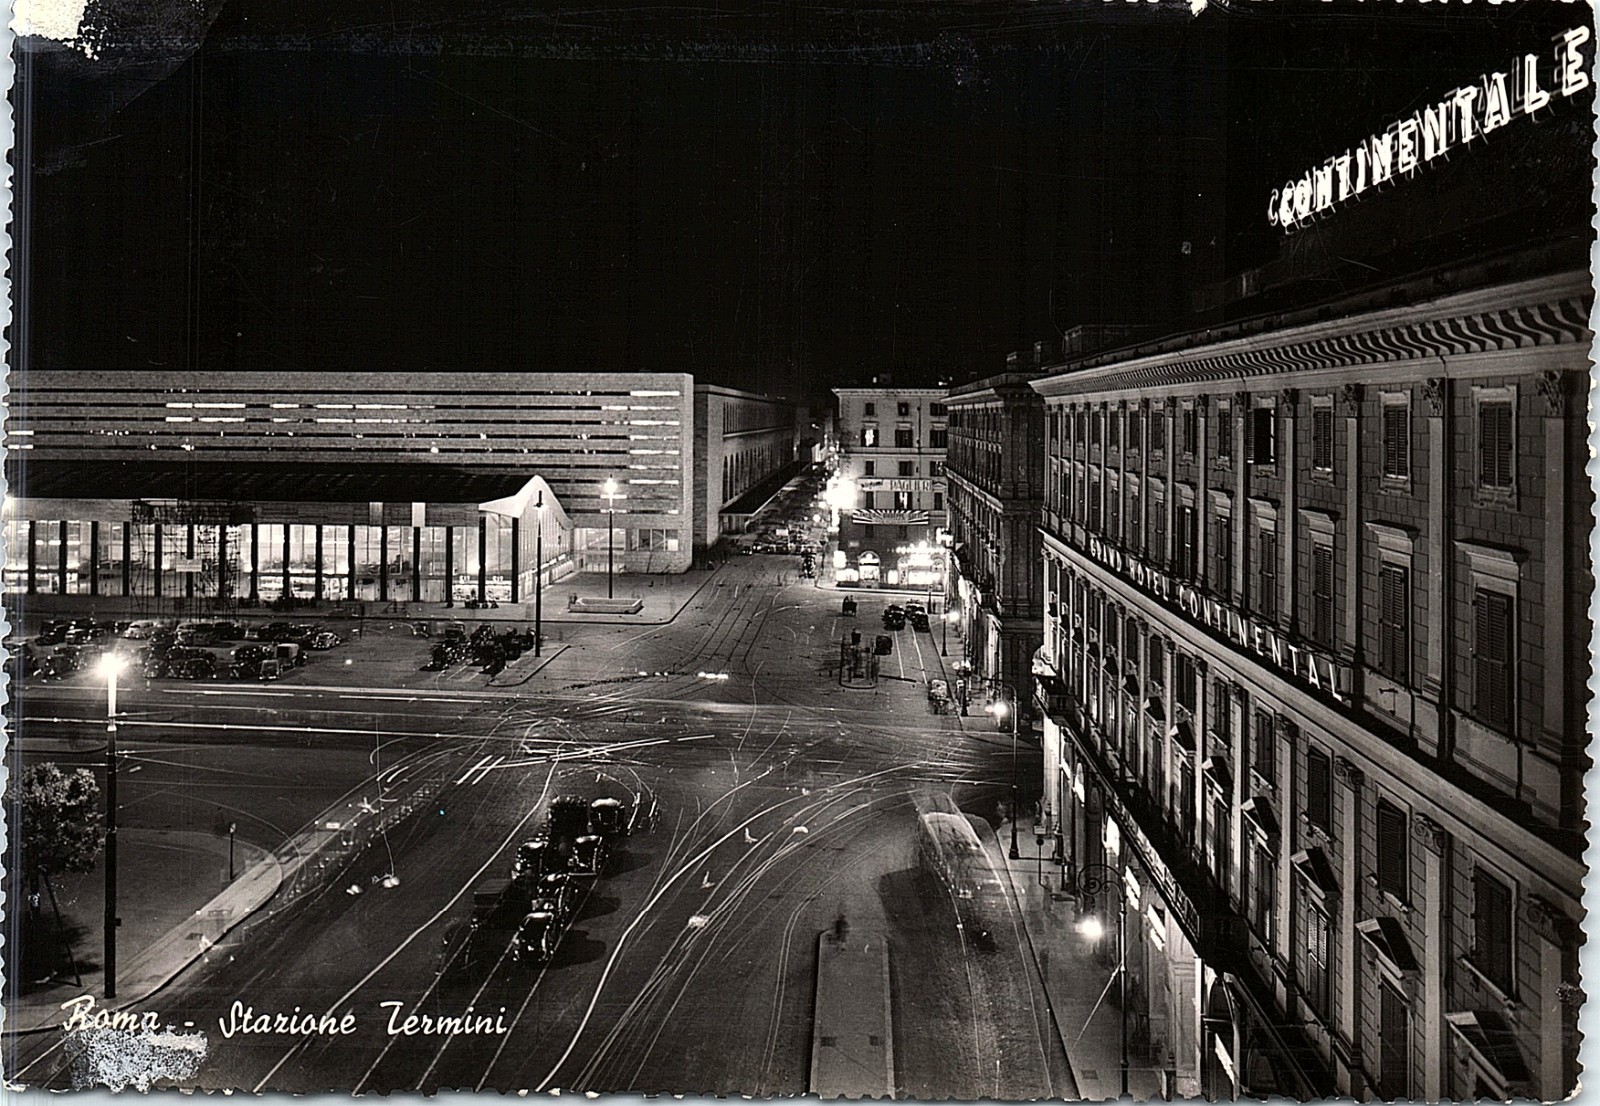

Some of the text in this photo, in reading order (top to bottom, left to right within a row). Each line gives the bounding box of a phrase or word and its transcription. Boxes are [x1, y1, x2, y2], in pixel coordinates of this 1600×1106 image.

[1268, 25, 1591, 227] CONTINENTALE
[1090, 538, 1343, 702] GRAND HOTEL CONTINENTAL
